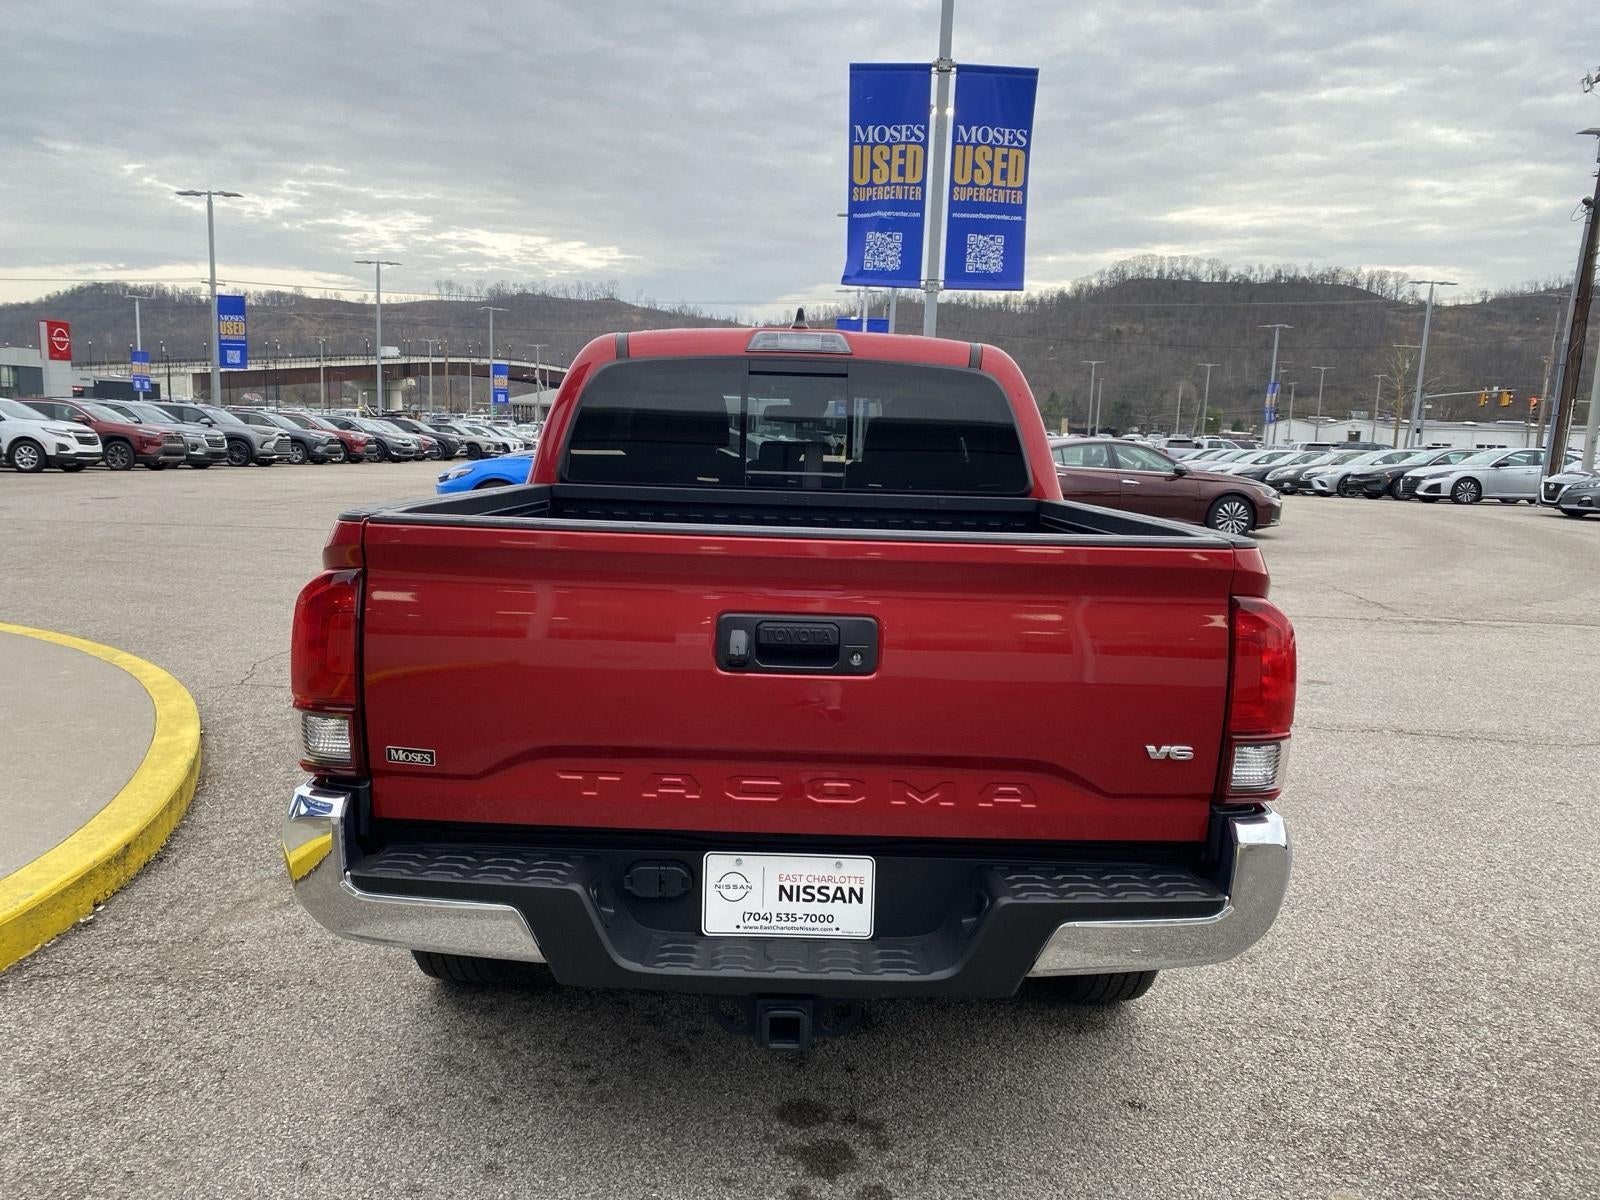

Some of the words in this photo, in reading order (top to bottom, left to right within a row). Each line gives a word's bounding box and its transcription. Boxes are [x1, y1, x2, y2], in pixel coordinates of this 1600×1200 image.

[854, 125, 925, 143] MOSES
[956, 125, 1028, 147] MOSES
[853, 144, 924, 185] USED
[954, 145, 1026, 187] USED
[853, 186, 922, 201] SUPERCENTER
[953, 187, 1023, 204] SUPERCENTER
[219, 321, 246, 335] USED
[762, 627, 835, 643] TOYOTA
[1145, 745, 1194, 760] V6
[555, 769, 1039, 808] TACOMA
[778, 873, 803, 883] EAST
[805, 874, 865, 885] CHARLOTTE
[778, 884, 864, 904] NISSAN
[742, 911, 773, 924] (704)
[775, 912, 835, 924] 535-7000
[742, 924, 834, 933] www.EastCharlotteNissan.com
